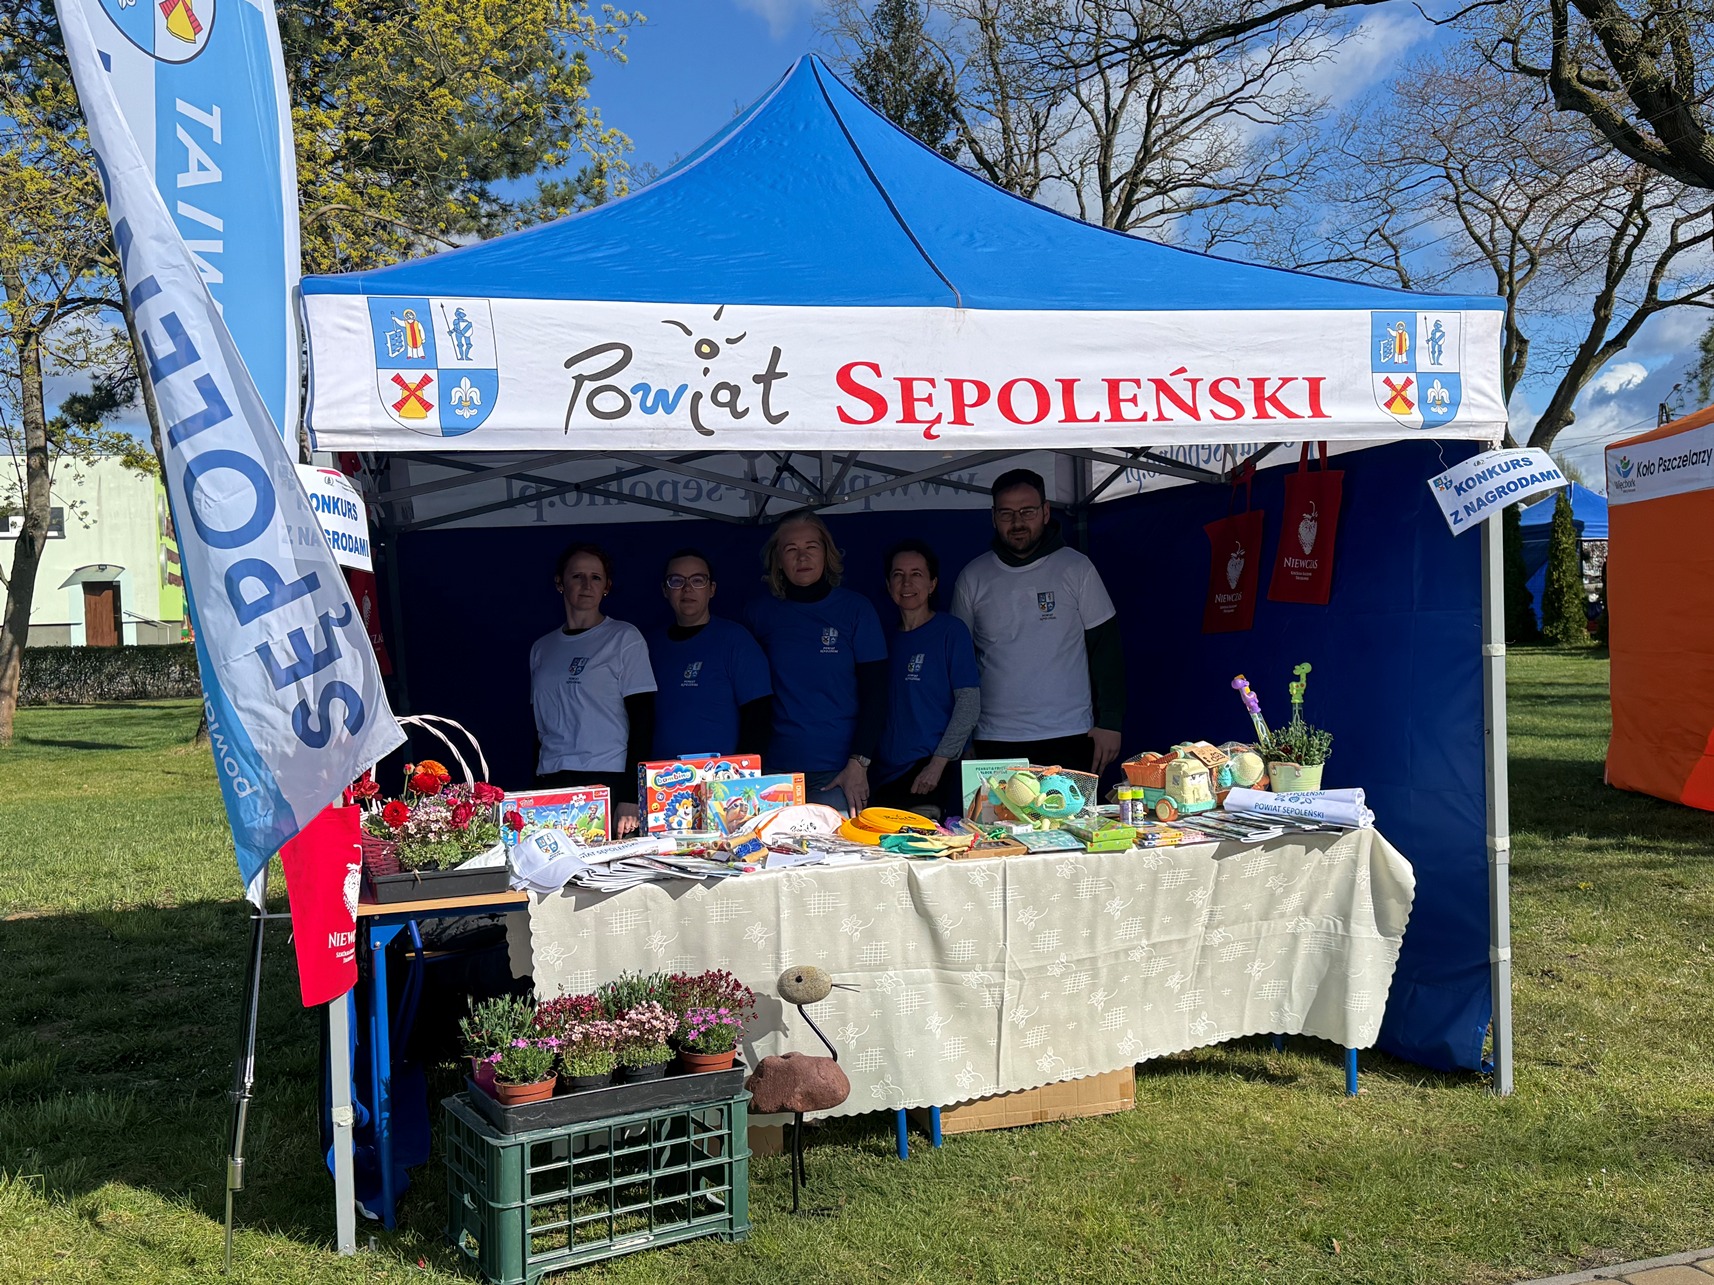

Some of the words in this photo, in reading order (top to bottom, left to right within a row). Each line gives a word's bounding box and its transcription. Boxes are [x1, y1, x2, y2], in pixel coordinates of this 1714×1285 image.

[563, 342, 790, 437] Powiat
[835, 361, 1332, 441] SĘPOLEŃSKI
[1454, 457, 1533, 496] KONKURS
[1636, 460, 1656, 478] Koło
[1657, 448, 1713, 474] Pszczelarzy
[1450, 510, 1463, 525] Z
[1463, 469, 1562, 517] NAGRODAMI
[1254, 802, 1281, 813] POWIAT
[1283, 805, 1325, 819] SĘPOLEŃSKI
